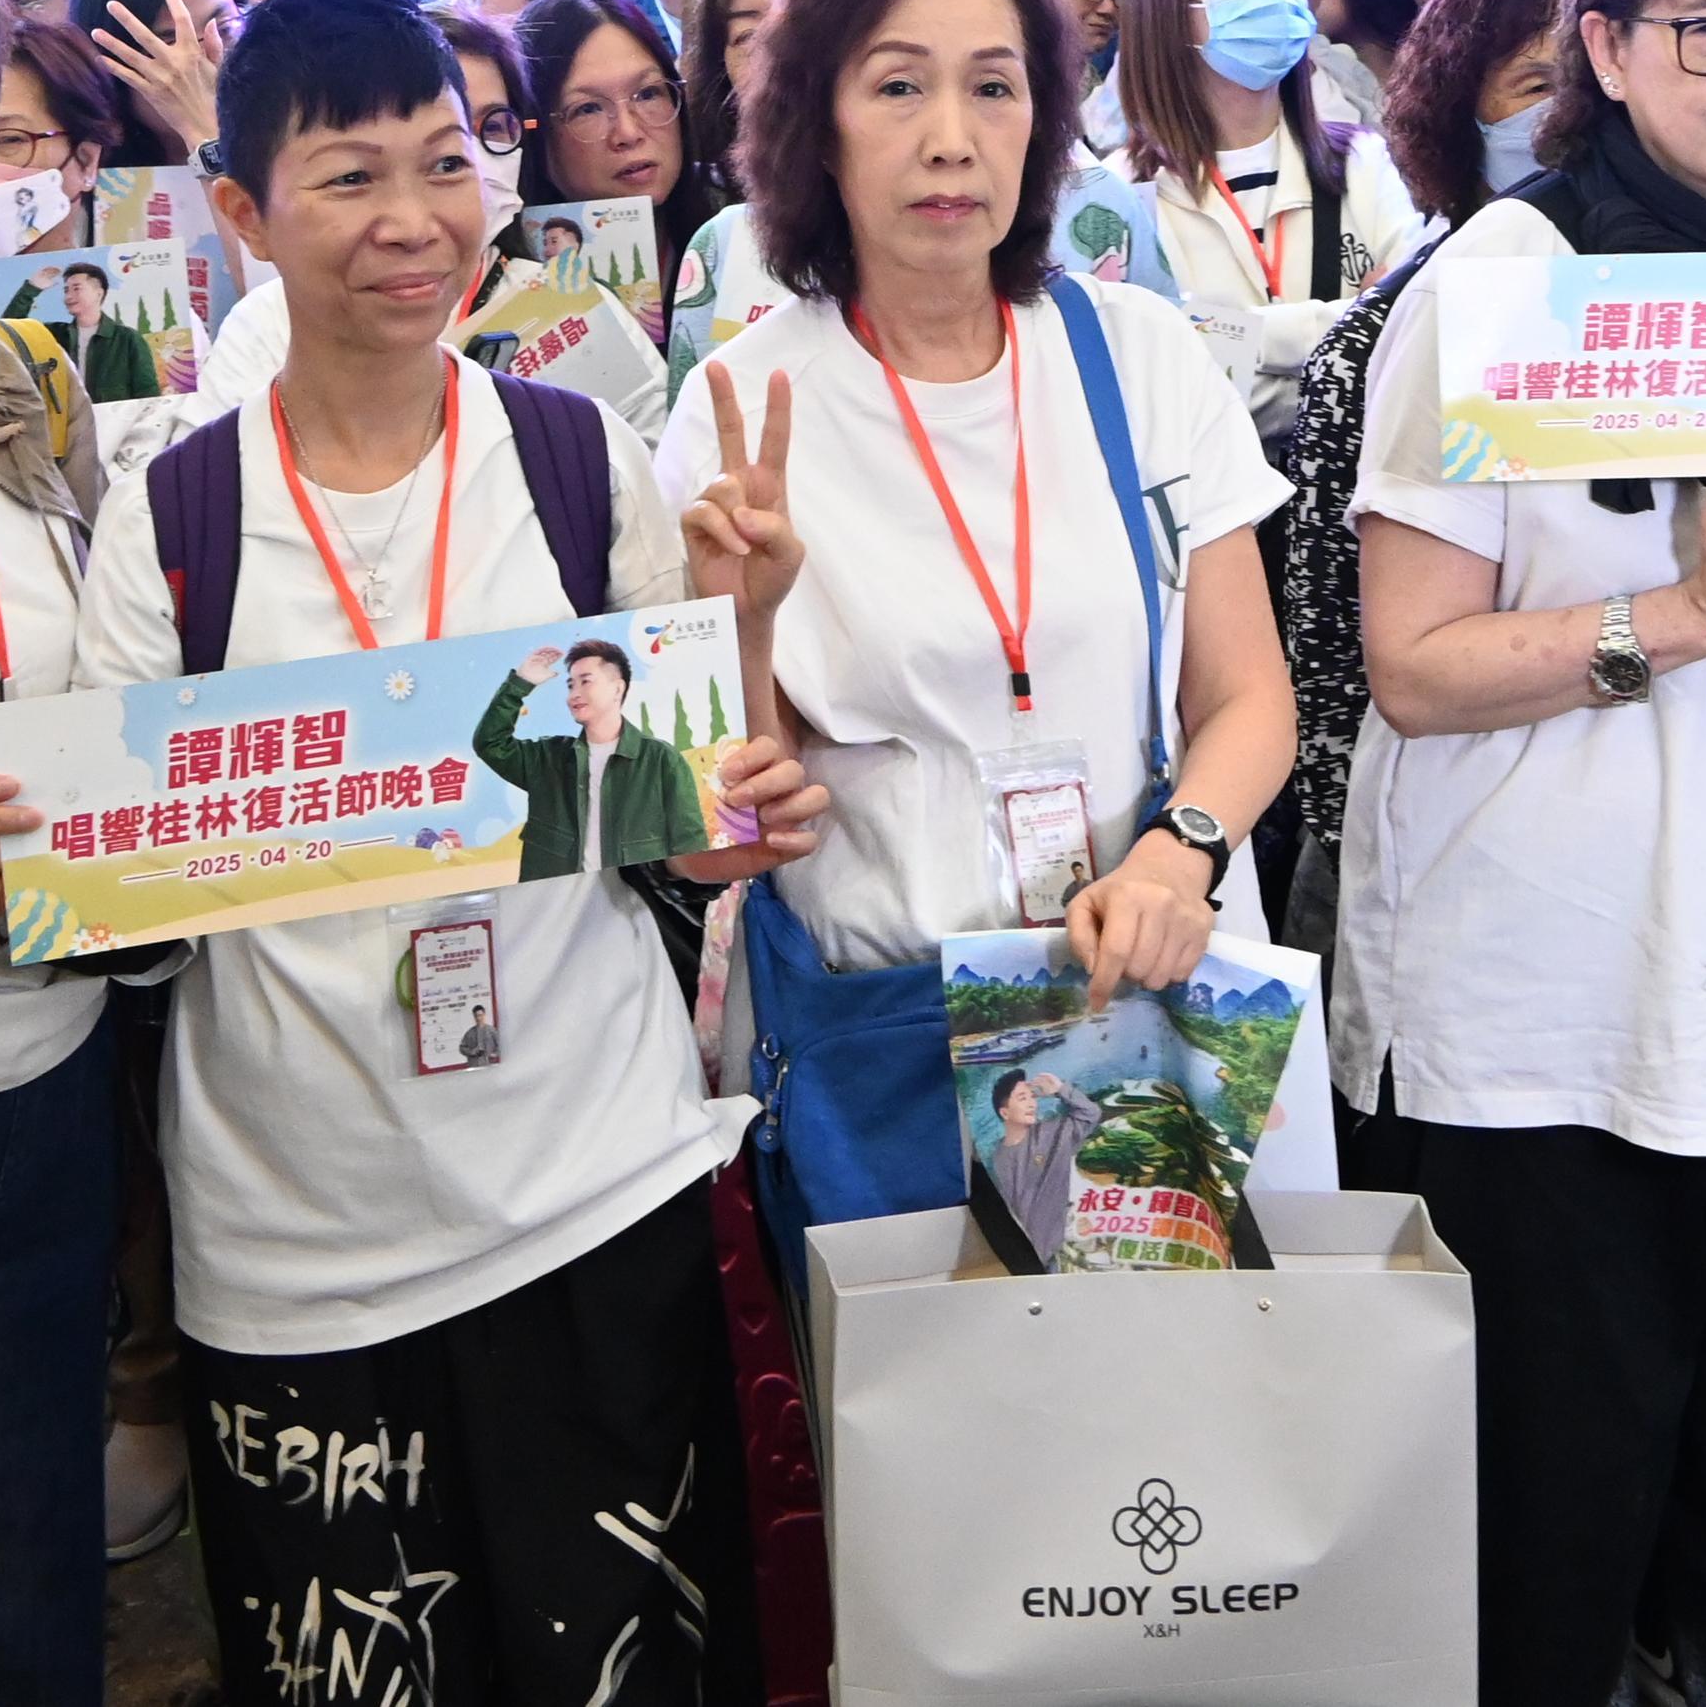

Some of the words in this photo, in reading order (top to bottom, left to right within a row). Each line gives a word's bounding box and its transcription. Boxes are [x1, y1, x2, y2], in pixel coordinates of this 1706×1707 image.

[1592, 411, 1641, 431] 2025
[166, 709, 348, 792] 譚輝智
[49, 755, 471, 862] 唱響桂林復活節晚會
[185, 852, 242, 880] 2025
[1022, 1585, 1152, 1619] ENJOY
[1172, 1582, 1300, 1616] SLEEP
[1142, 1622, 1181, 1639] X&H
